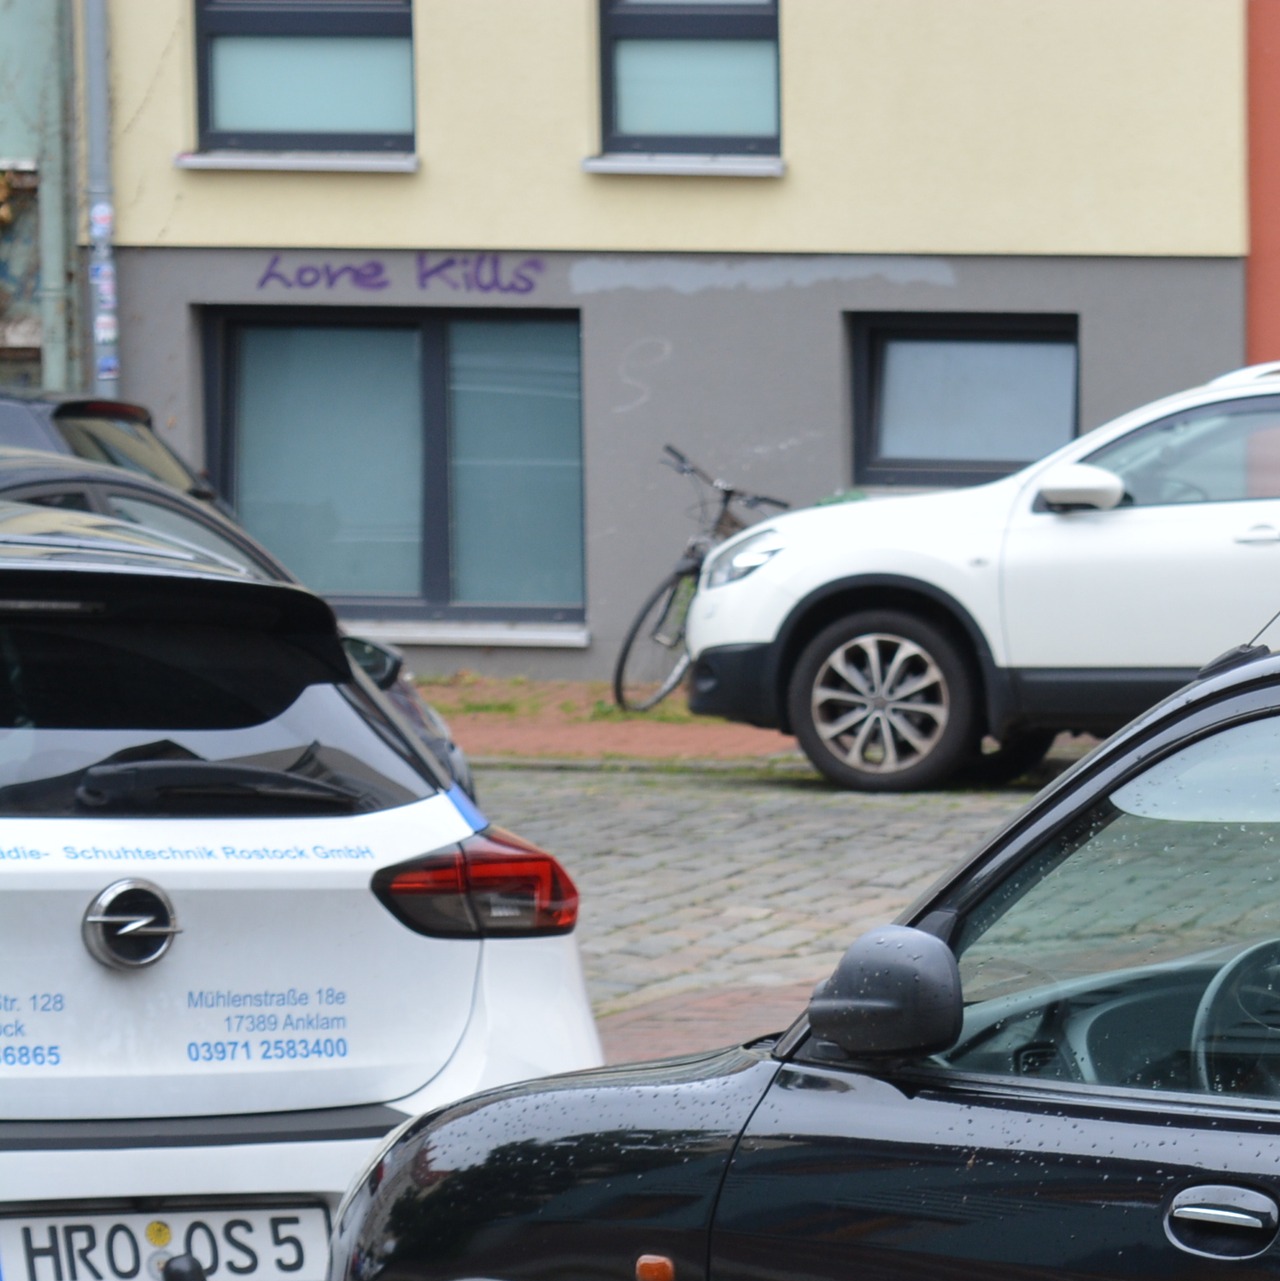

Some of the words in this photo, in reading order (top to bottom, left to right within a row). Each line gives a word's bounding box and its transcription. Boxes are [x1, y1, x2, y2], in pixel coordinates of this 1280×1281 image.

[416, 252, 547, 294] Kills
[62, 845, 218, 860] Schuhtechnik
[221, 846, 309, 860] Rostock
[312, 845, 375, 860] GmbH
[29, 992, 65, 1012] 128
[187, 988, 309, 1008] Mühlenstraße
[315, 988, 347, 1006] 18e
[225, 1014, 279, 1032] 17389
[282, 1013, 347, 1031] Anklam
[0, 1045, 61, 1067] 6865
[187, 1041, 252, 1062] 03971
[259, 1038, 348, 1060] 2583400
[269, 1216, 305, 1272] 5
